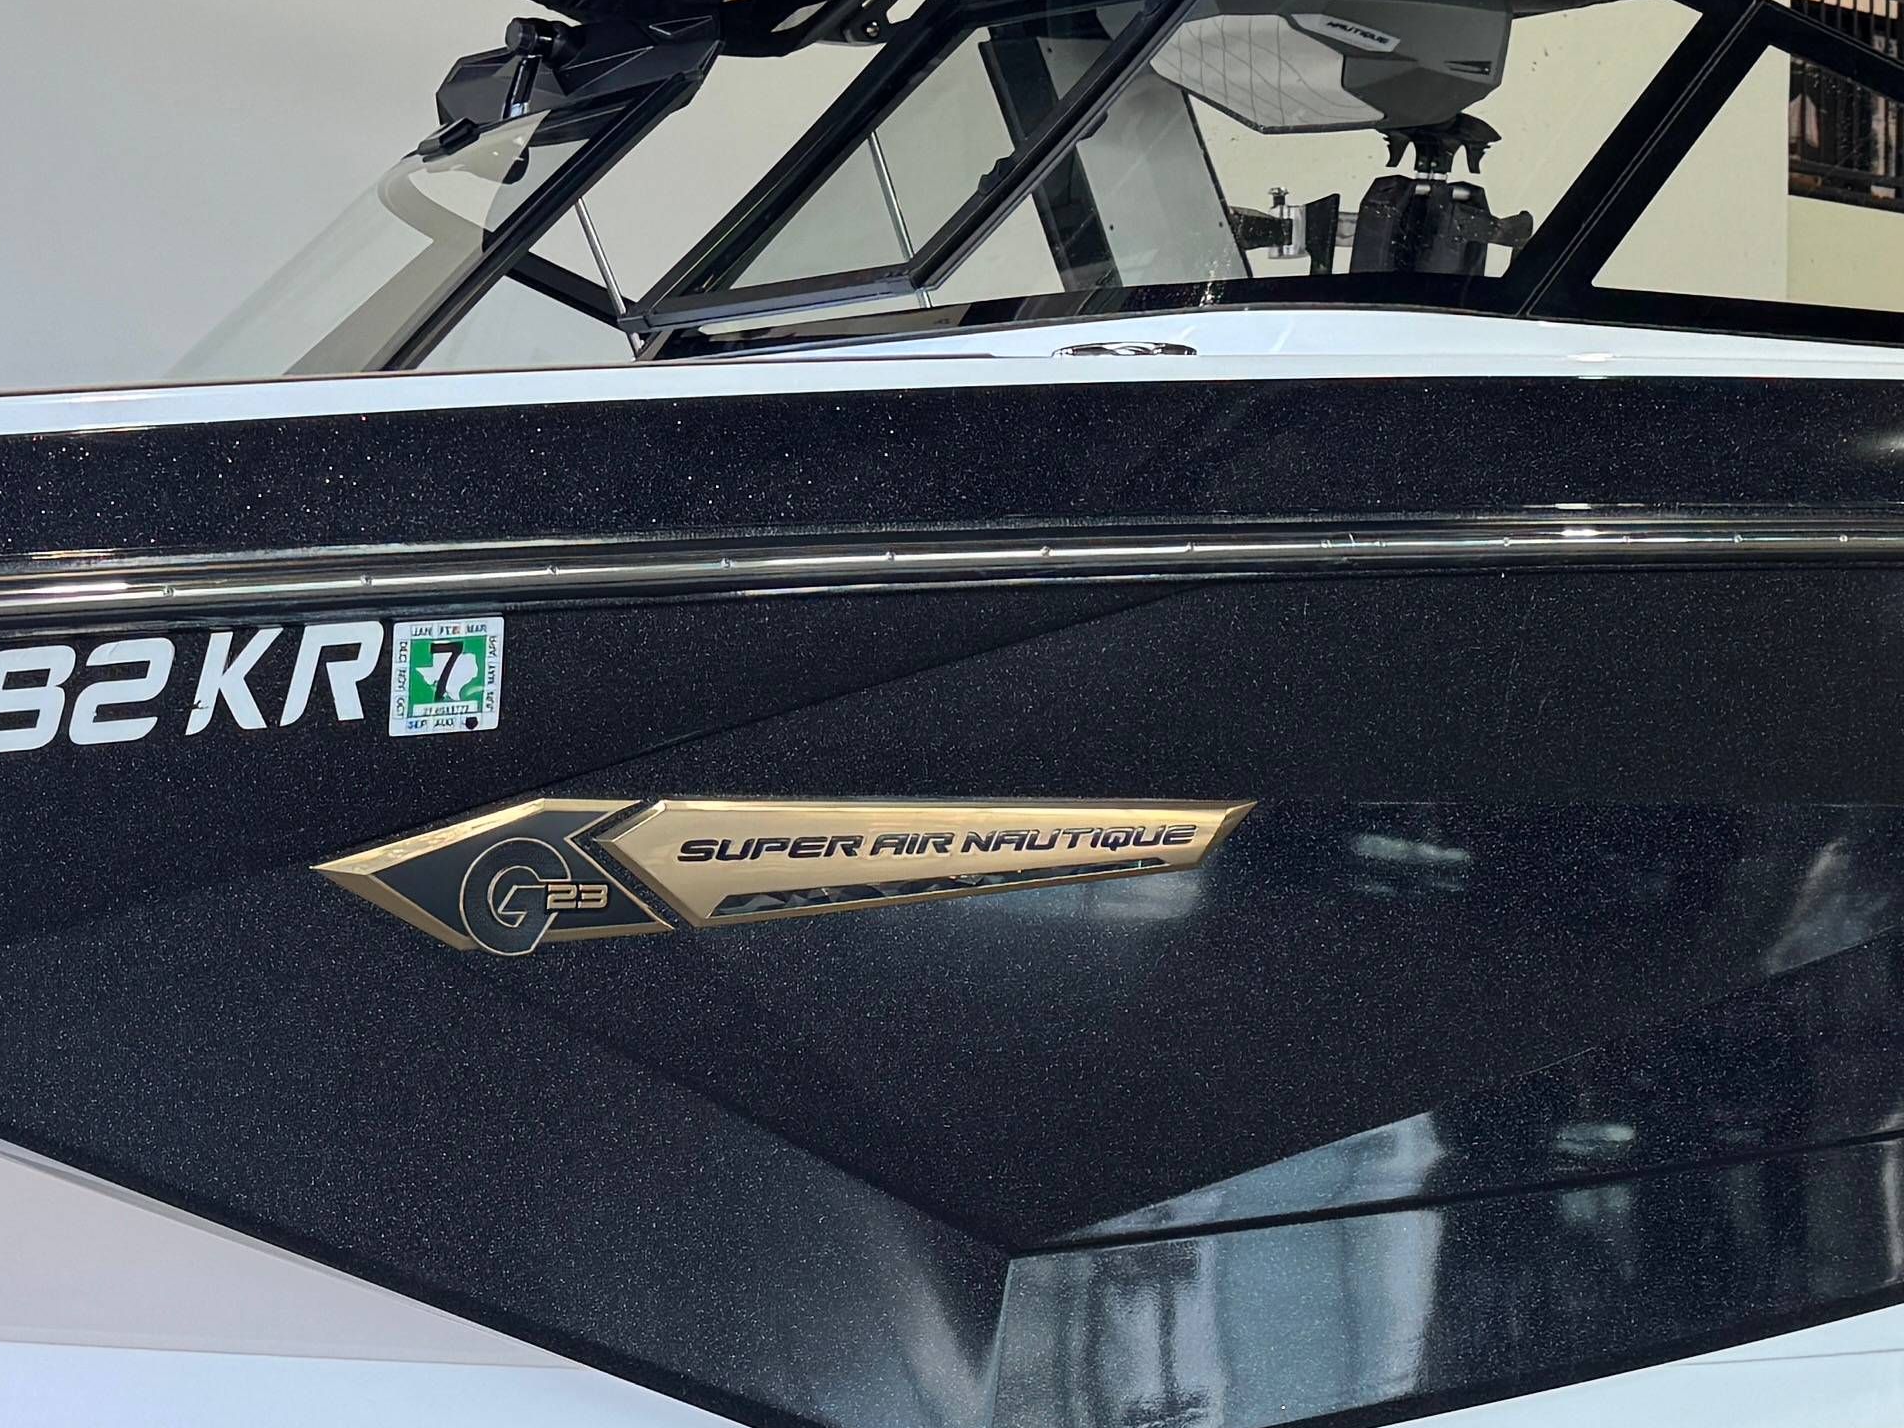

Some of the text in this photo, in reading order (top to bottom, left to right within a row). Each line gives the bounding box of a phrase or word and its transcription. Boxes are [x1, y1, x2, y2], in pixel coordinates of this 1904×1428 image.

[186, 620, 383, 736] KR
[430, 642, 464, 702] 7
[677, 824, 1197, 863] SUPER AIR NAUTIQUE
